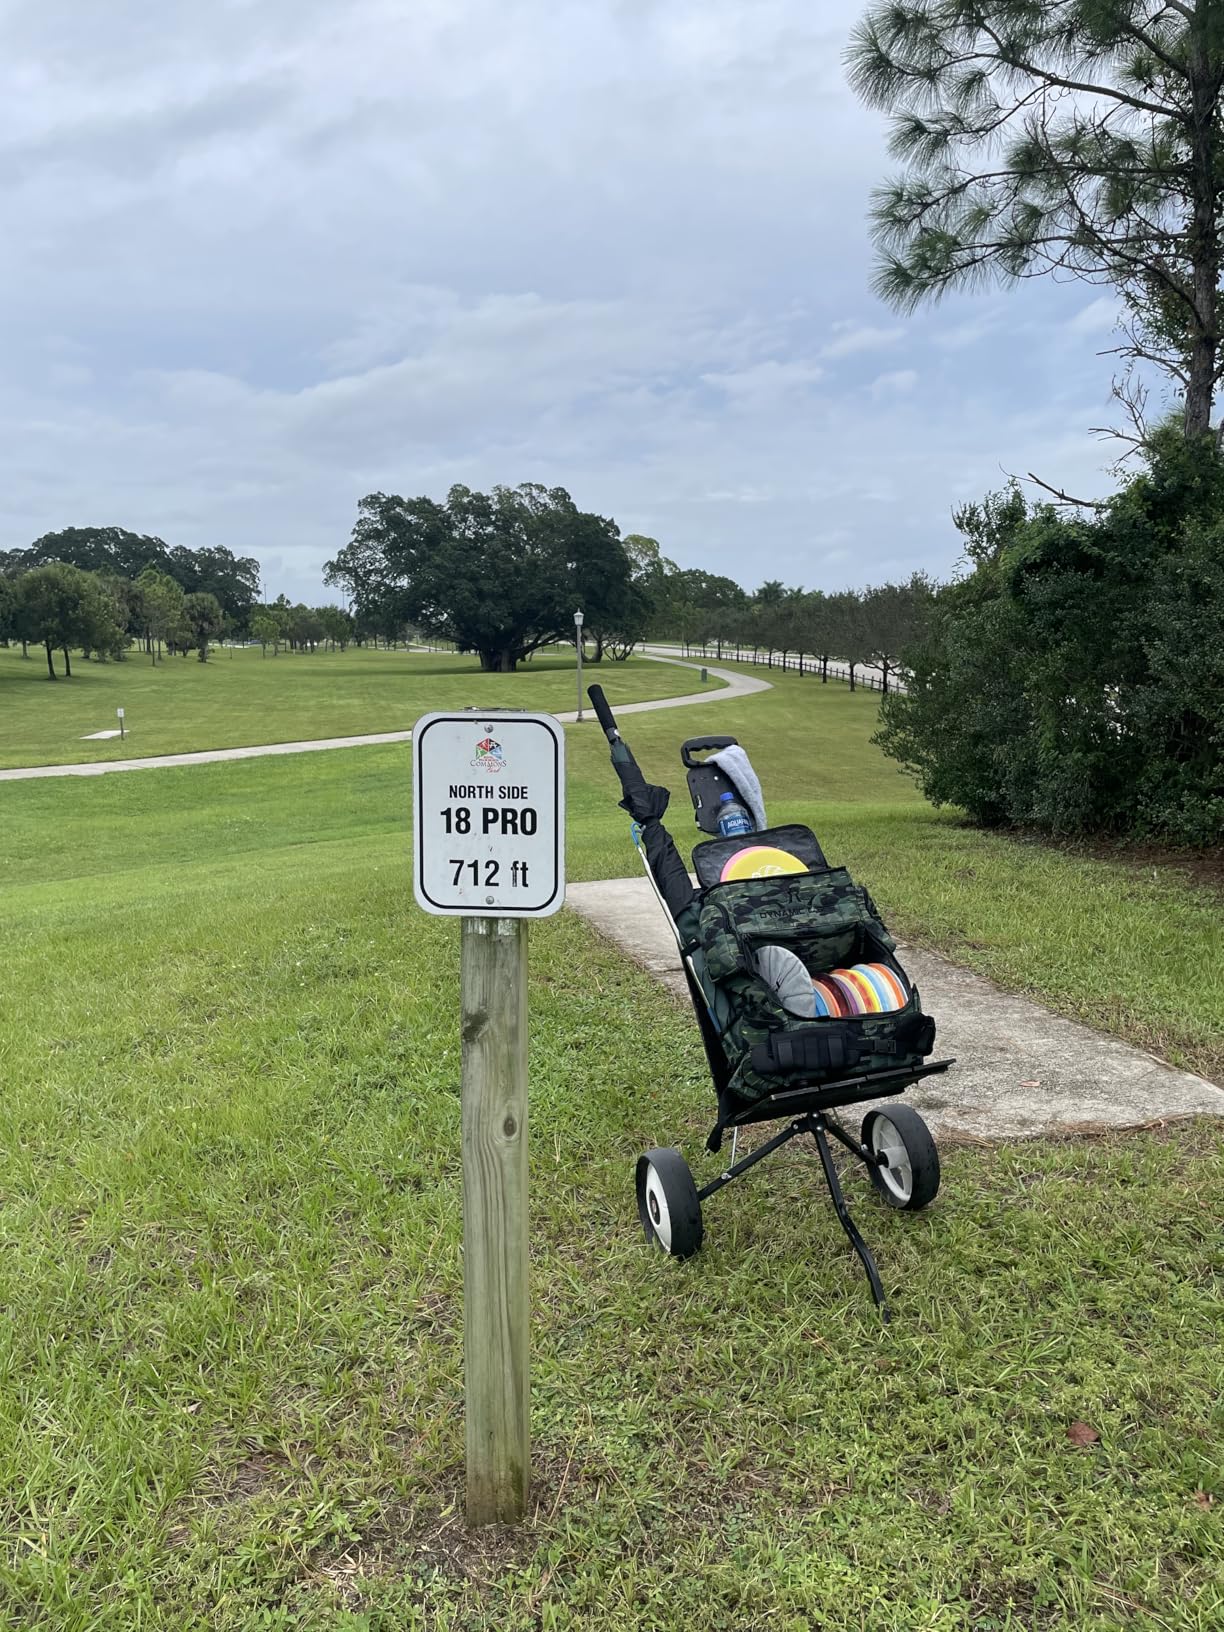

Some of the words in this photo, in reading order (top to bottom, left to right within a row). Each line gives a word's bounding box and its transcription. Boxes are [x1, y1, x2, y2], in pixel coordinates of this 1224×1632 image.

[449, 785, 494, 799] NORTH
[498, 786, 528, 800] SIDE
[440, 807, 471, 834] 18
[482, 807, 537, 836] PRO
[449, 859, 499, 887] 712
[510, 861, 529, 887] ft
